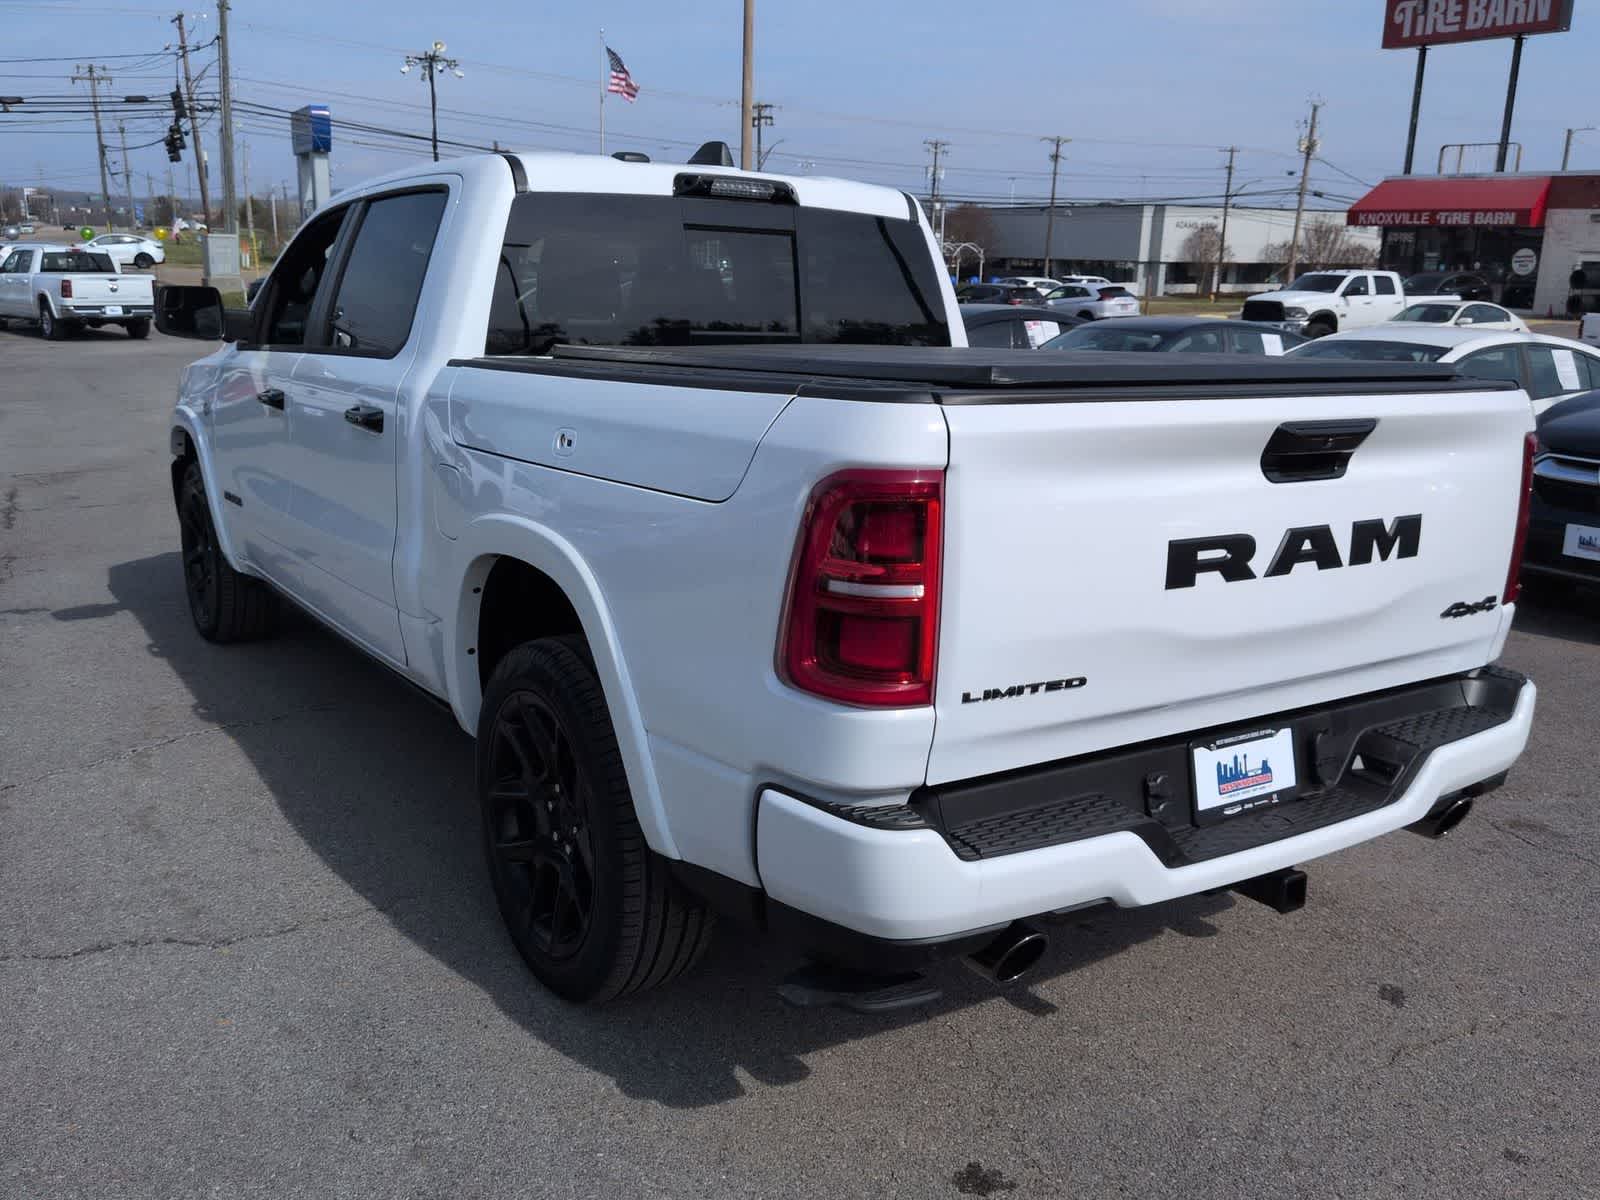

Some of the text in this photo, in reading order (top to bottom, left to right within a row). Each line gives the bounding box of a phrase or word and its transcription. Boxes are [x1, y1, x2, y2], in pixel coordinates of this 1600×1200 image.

[1465, 0, 1551, 30] BARN
[1358, 211, 1430, 225] KNOXVILLE
[1474, 210, 1516, 225] BARN
[1164, 513, 1423, 590] RAM
[961, 676, 1088, 704] LIMITED
